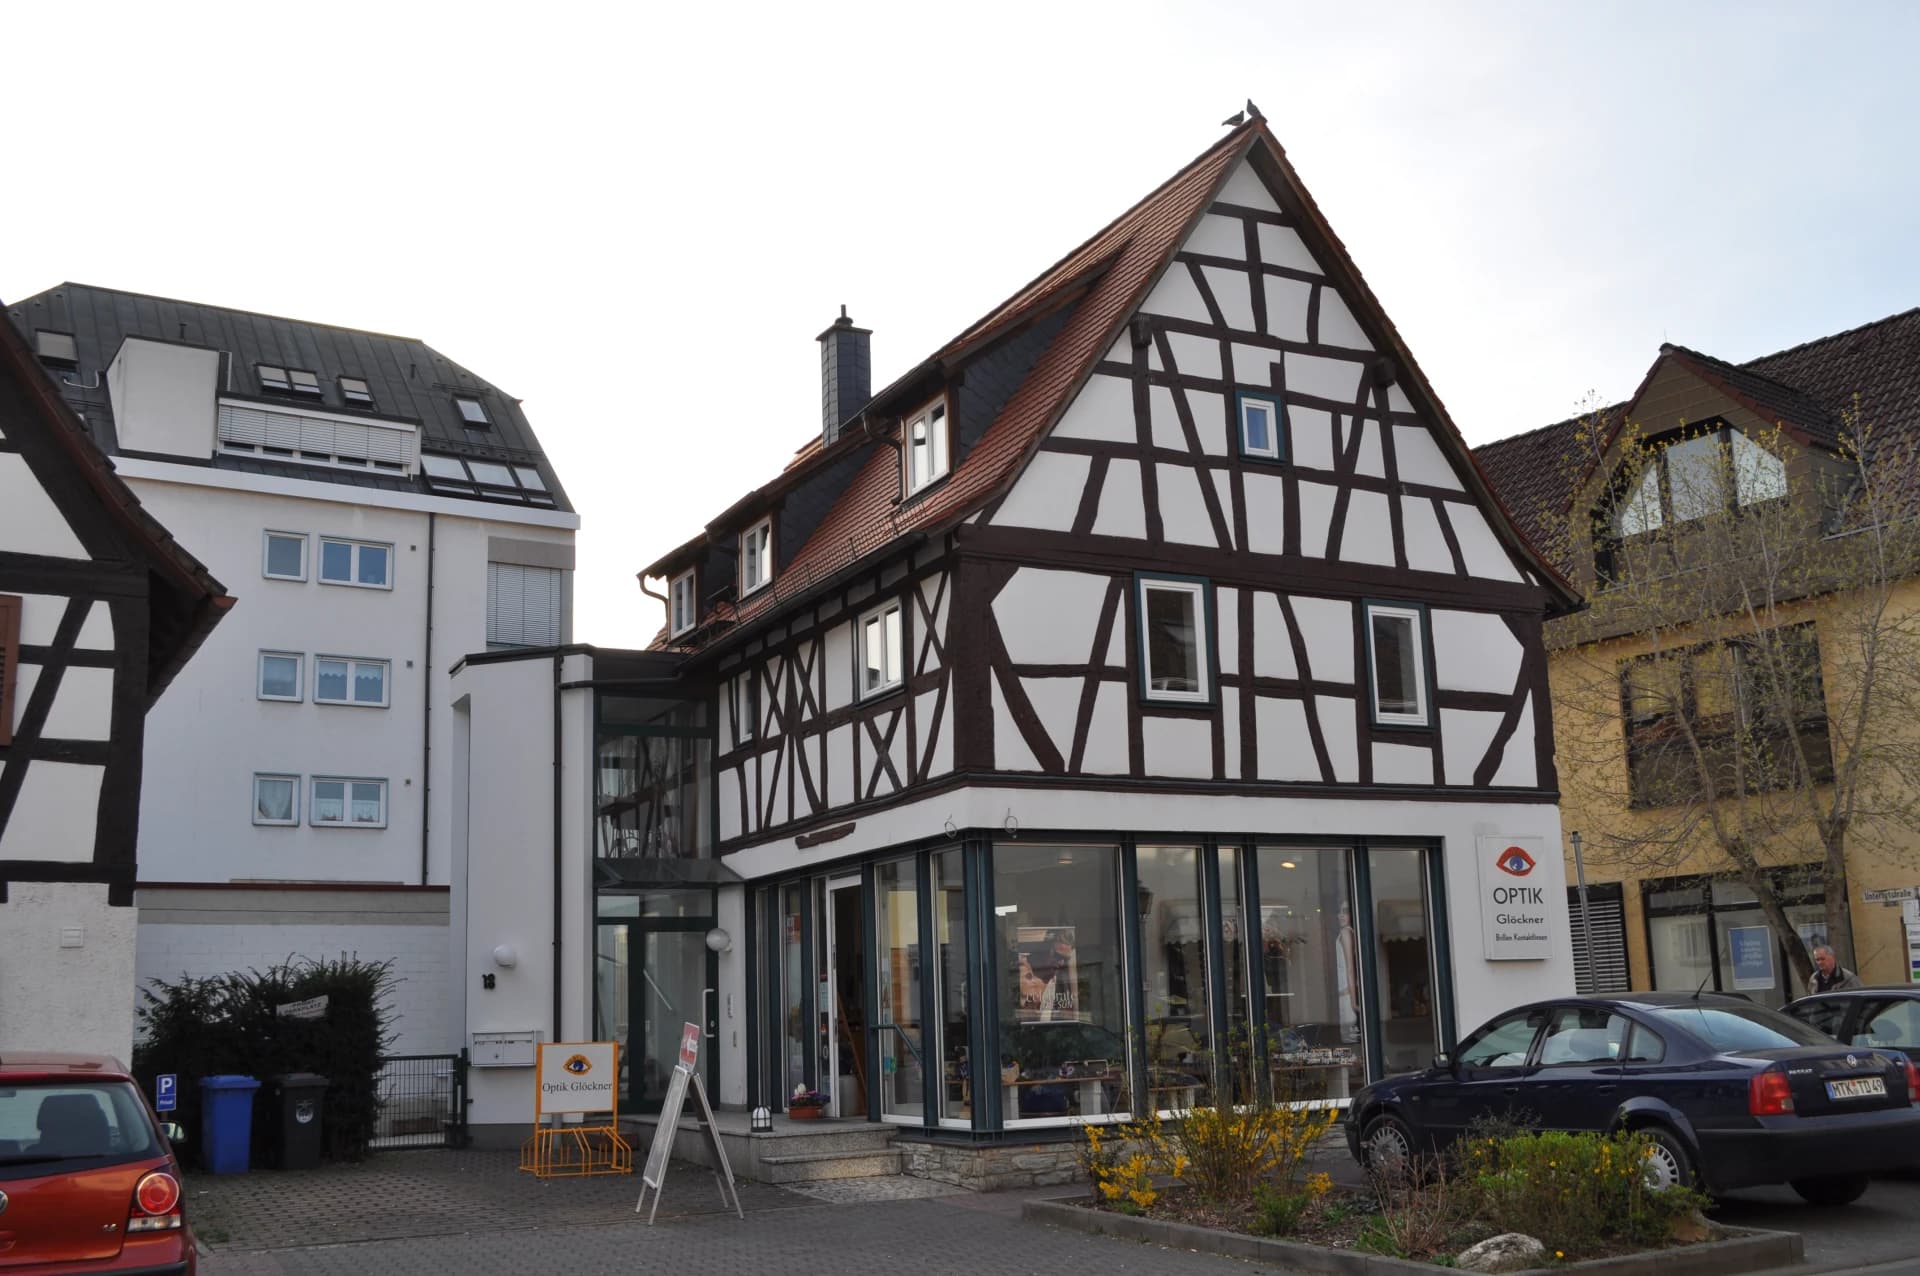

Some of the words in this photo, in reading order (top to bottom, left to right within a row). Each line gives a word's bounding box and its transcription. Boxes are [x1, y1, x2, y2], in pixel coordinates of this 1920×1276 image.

[1493, 887, 1544, 904] OPTIK
[1496, 913, 1544, 924] Glöckner
[1058, 1000, 1073, 1008] SUN
[161, 1077, 173, 1093] P
[542, 1082, 569, 1094] Optik
[570, 1081, 613, 1092] Glöckner
[1832, 1081, 1854, 1097] MTK
